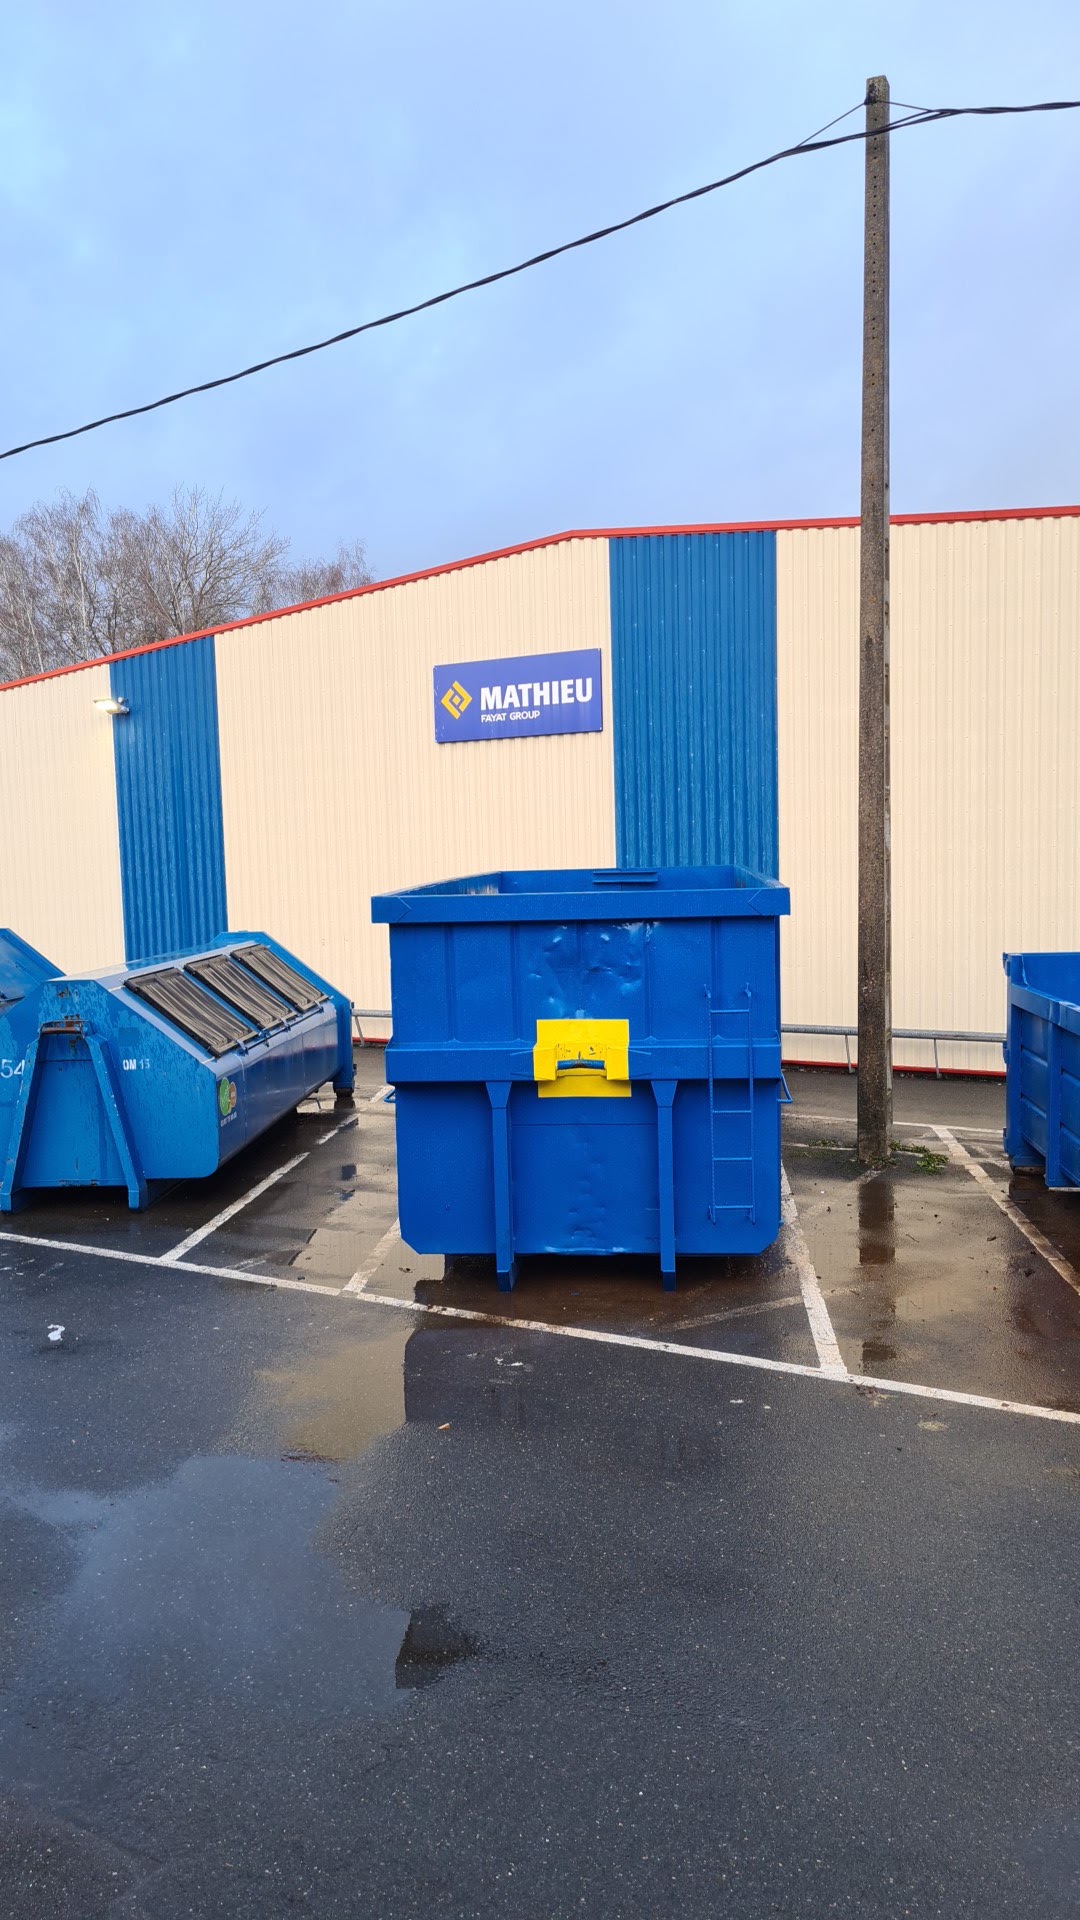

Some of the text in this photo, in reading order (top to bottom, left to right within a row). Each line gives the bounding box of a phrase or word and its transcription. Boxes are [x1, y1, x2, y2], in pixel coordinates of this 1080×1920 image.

[480, 678, 592, 710] MATHIEU
[481, 711, 540, 722] FAYAT GROUP
[0, 1059, 25, 1078] 54
